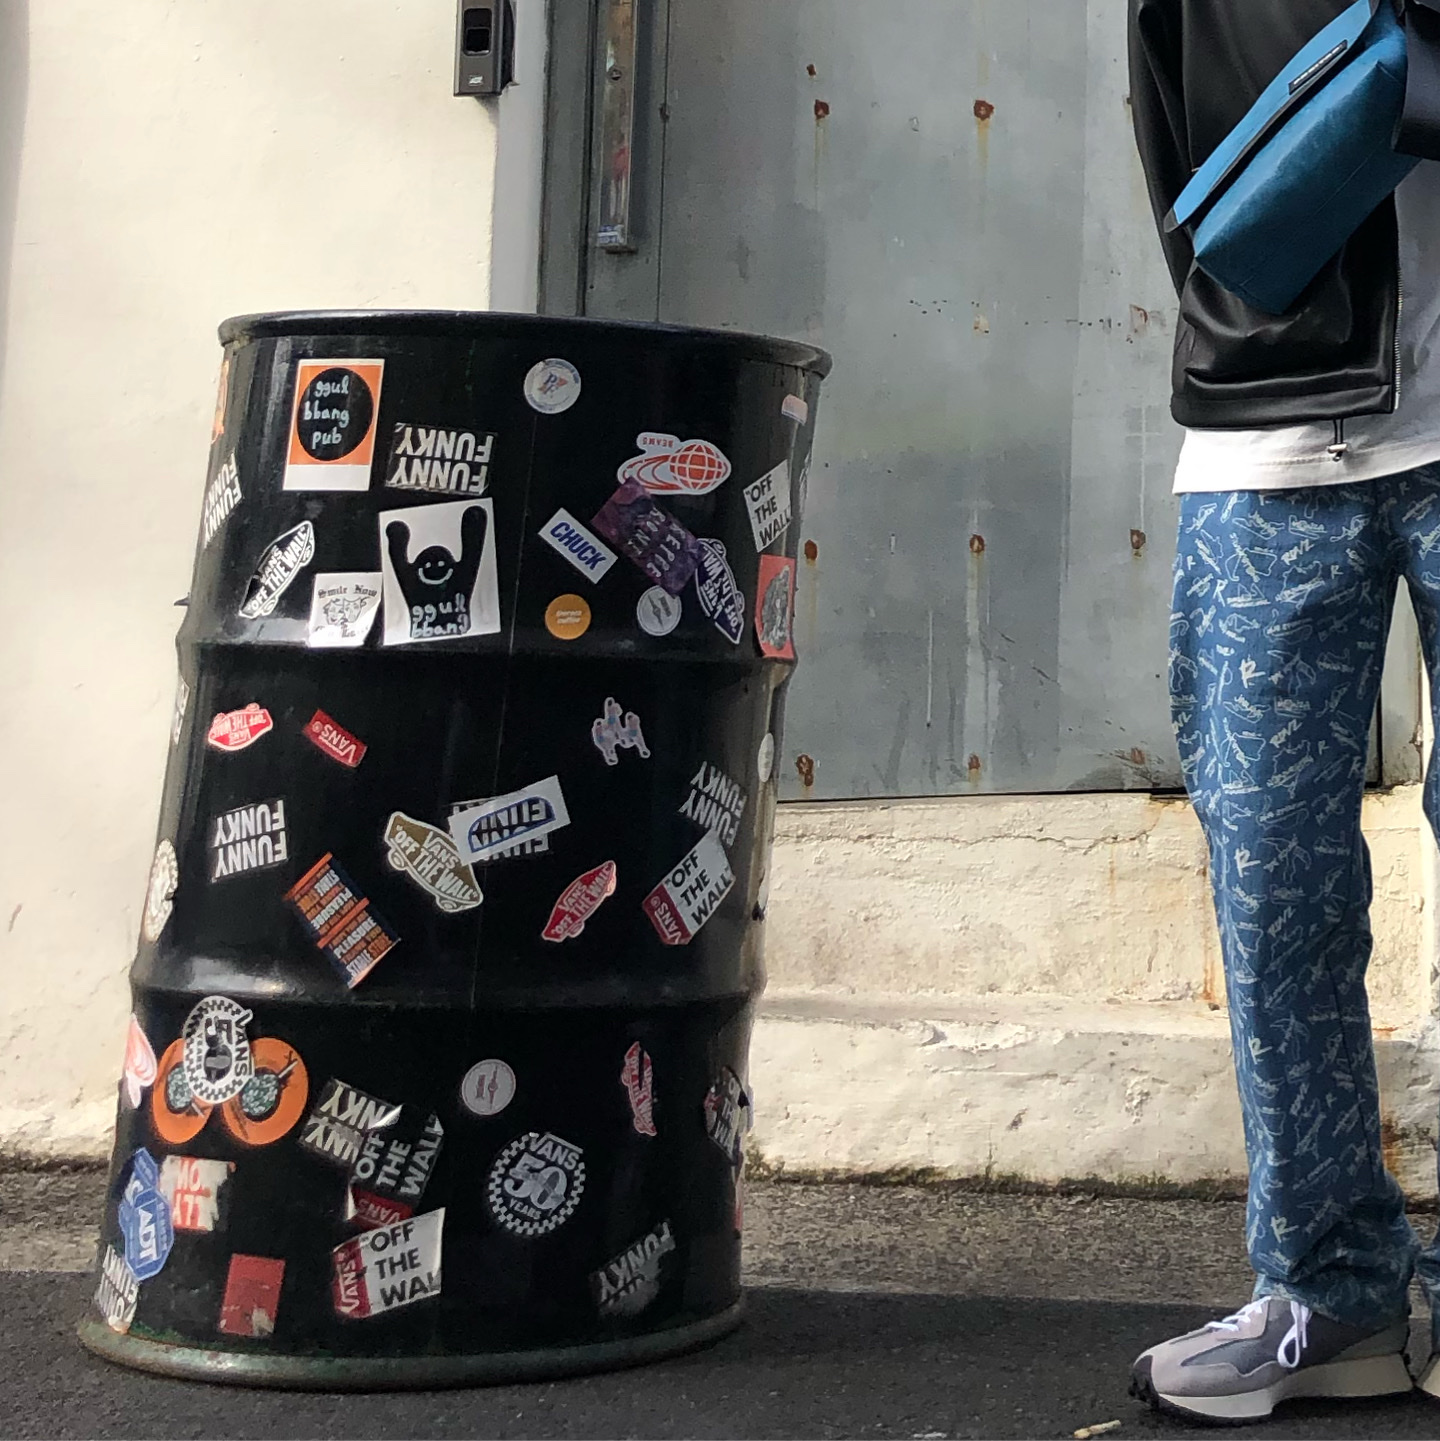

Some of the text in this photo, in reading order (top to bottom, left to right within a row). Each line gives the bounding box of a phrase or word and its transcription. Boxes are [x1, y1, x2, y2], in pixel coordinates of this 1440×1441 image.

[315, 375, 350, 397] ggul
[303, 401, 350, 428] bbang
[311, 430, 342, 450] pub
[395, 426, 494, 464] FUNKY
[642, 436, 674, 448] BEAMS
[389, 456, 488, 495] FUNNY
[754, 500, 779, 525] THE
[550, 521, 607, 571] CHUCK
[265, 561, 290, 591] THE
[317, 583, 378, 599] Smile Now
[231, 714, 249, 730] THE
[690, 761, 748, 816] FUNKY
[213, 800, 285, 848] FUNKY
[214, 831, 288, 879] FUNNY
[412, 845, 442, 883] THE
[422, 831, 461, 870] VANS
[561, 883, 587, 912] VANS
[680, 869, 710, 907] THE
[571, 894, 595, 925] THE
[332, 916, 376, 960] PLEASURE
[234, 1012, 252, 1076] VANS
[377, 1139, 412, 1189] THE
[527, 1134, 584, 1171] VANS
[503, 1152, 568, 1210] 50
[508, 1198, 543, 1221] YEARS
[138, 1208, 158, 1263] ADT
[374, 1247, 421, 1280] THE
